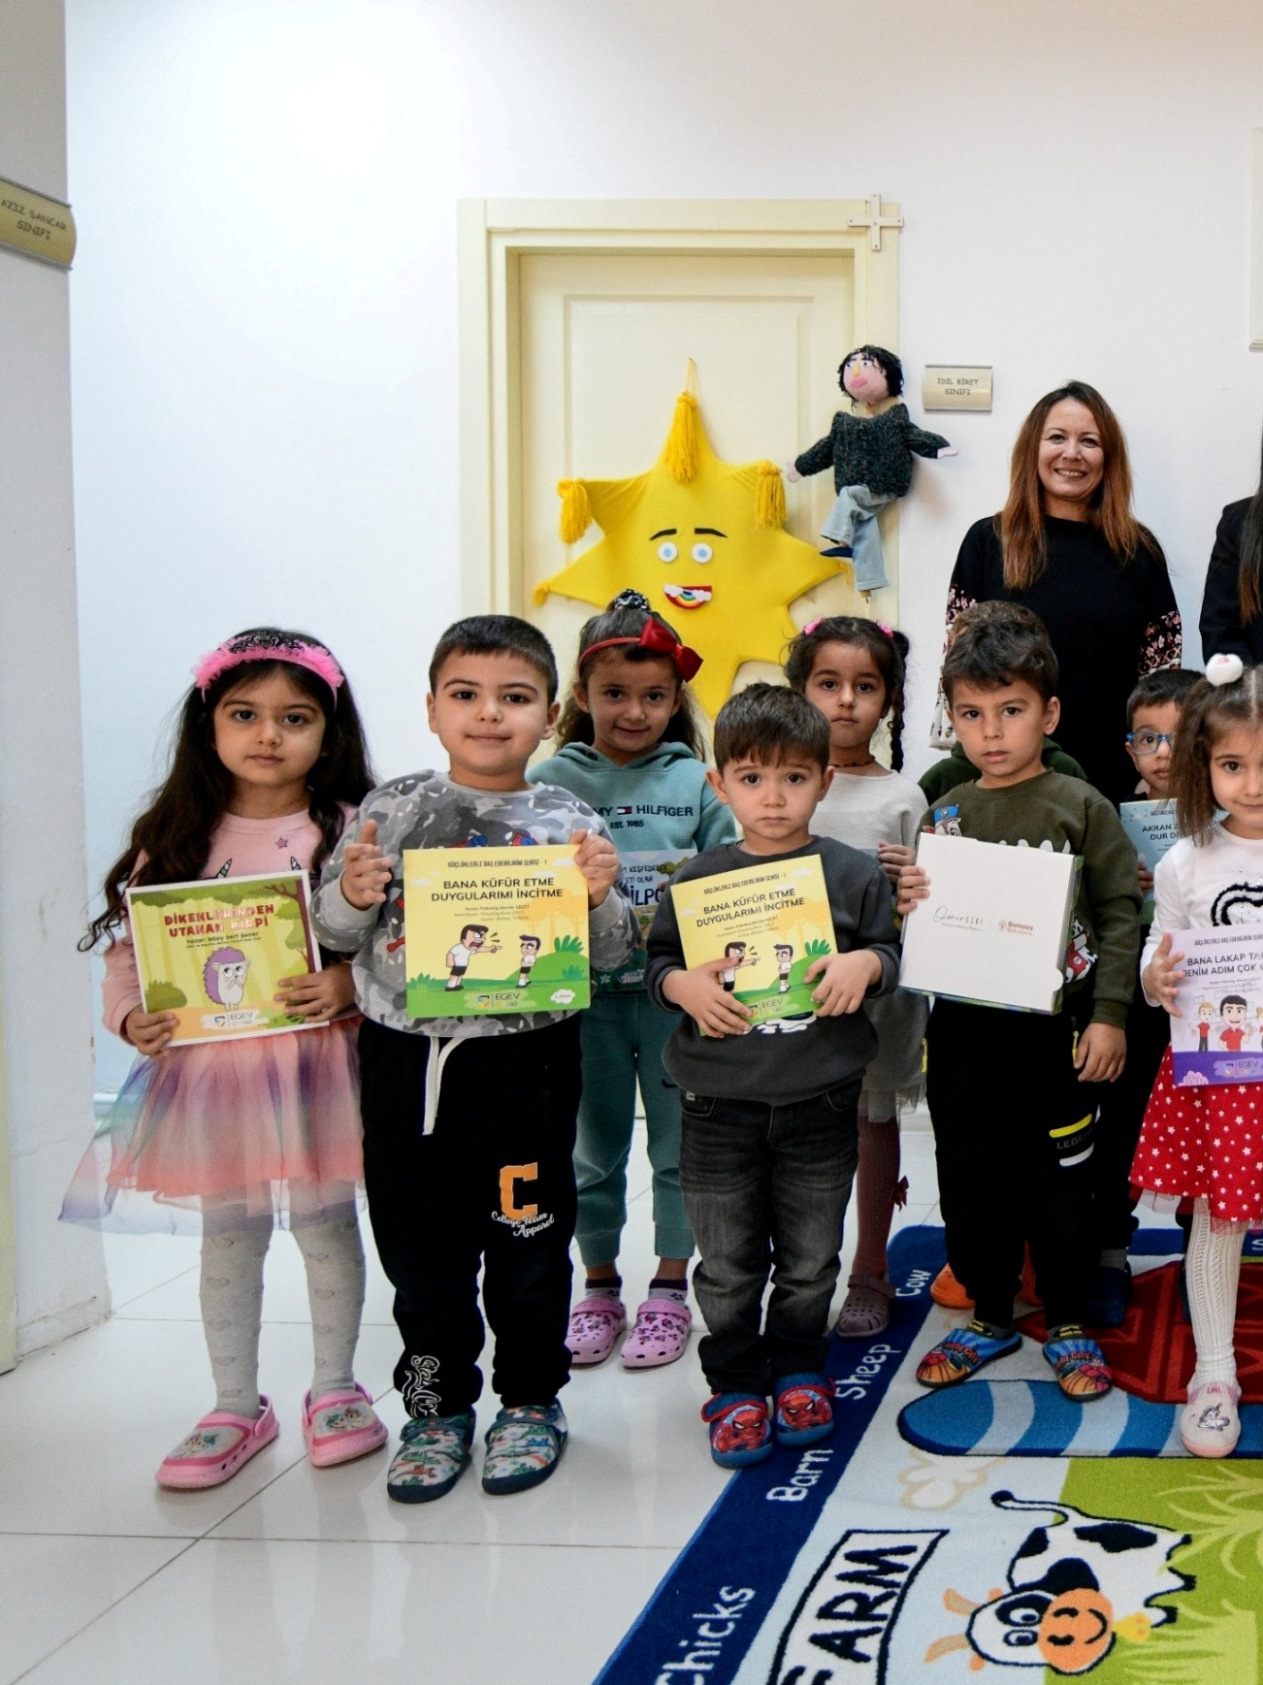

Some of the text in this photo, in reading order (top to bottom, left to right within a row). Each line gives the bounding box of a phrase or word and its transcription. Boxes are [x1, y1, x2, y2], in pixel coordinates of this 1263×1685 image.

[636, 805, 694, 817] HILFIGER
[1142, 824, 1172, 833] AKRAN
[1149, 833, 1168, 841] DUR
[443, 877, 555, 889] BANA KÜFÜR ETME
[431, 888, 563, 901] DUYGULARIMI İNCİTME
[703, 888, 796, 915] BANA KÜFÜR ETME
[696, 907, 763, 928] DUYGULARIMI
[764, 897, 805, 912] İNCİTME
[169, 922, 224, 938] UTANAN
[1187, 955, 1213, 966] BANA
[1214, 953, 1246, 963] LAKAP
[1210, 966, 1235, 975] ADIM
[1237, 963, 1257, 974] ÇOK
[499, 1162, 538, 1221] C
[513, 1213, 554, 1238] Apparel
[521, 1212, 548, 1225] Team
[895, 1269, 932, 1298] Cow
[834, 1344, 901, 1400] Sheep
[766, 1449, 834, 1502] Barn
